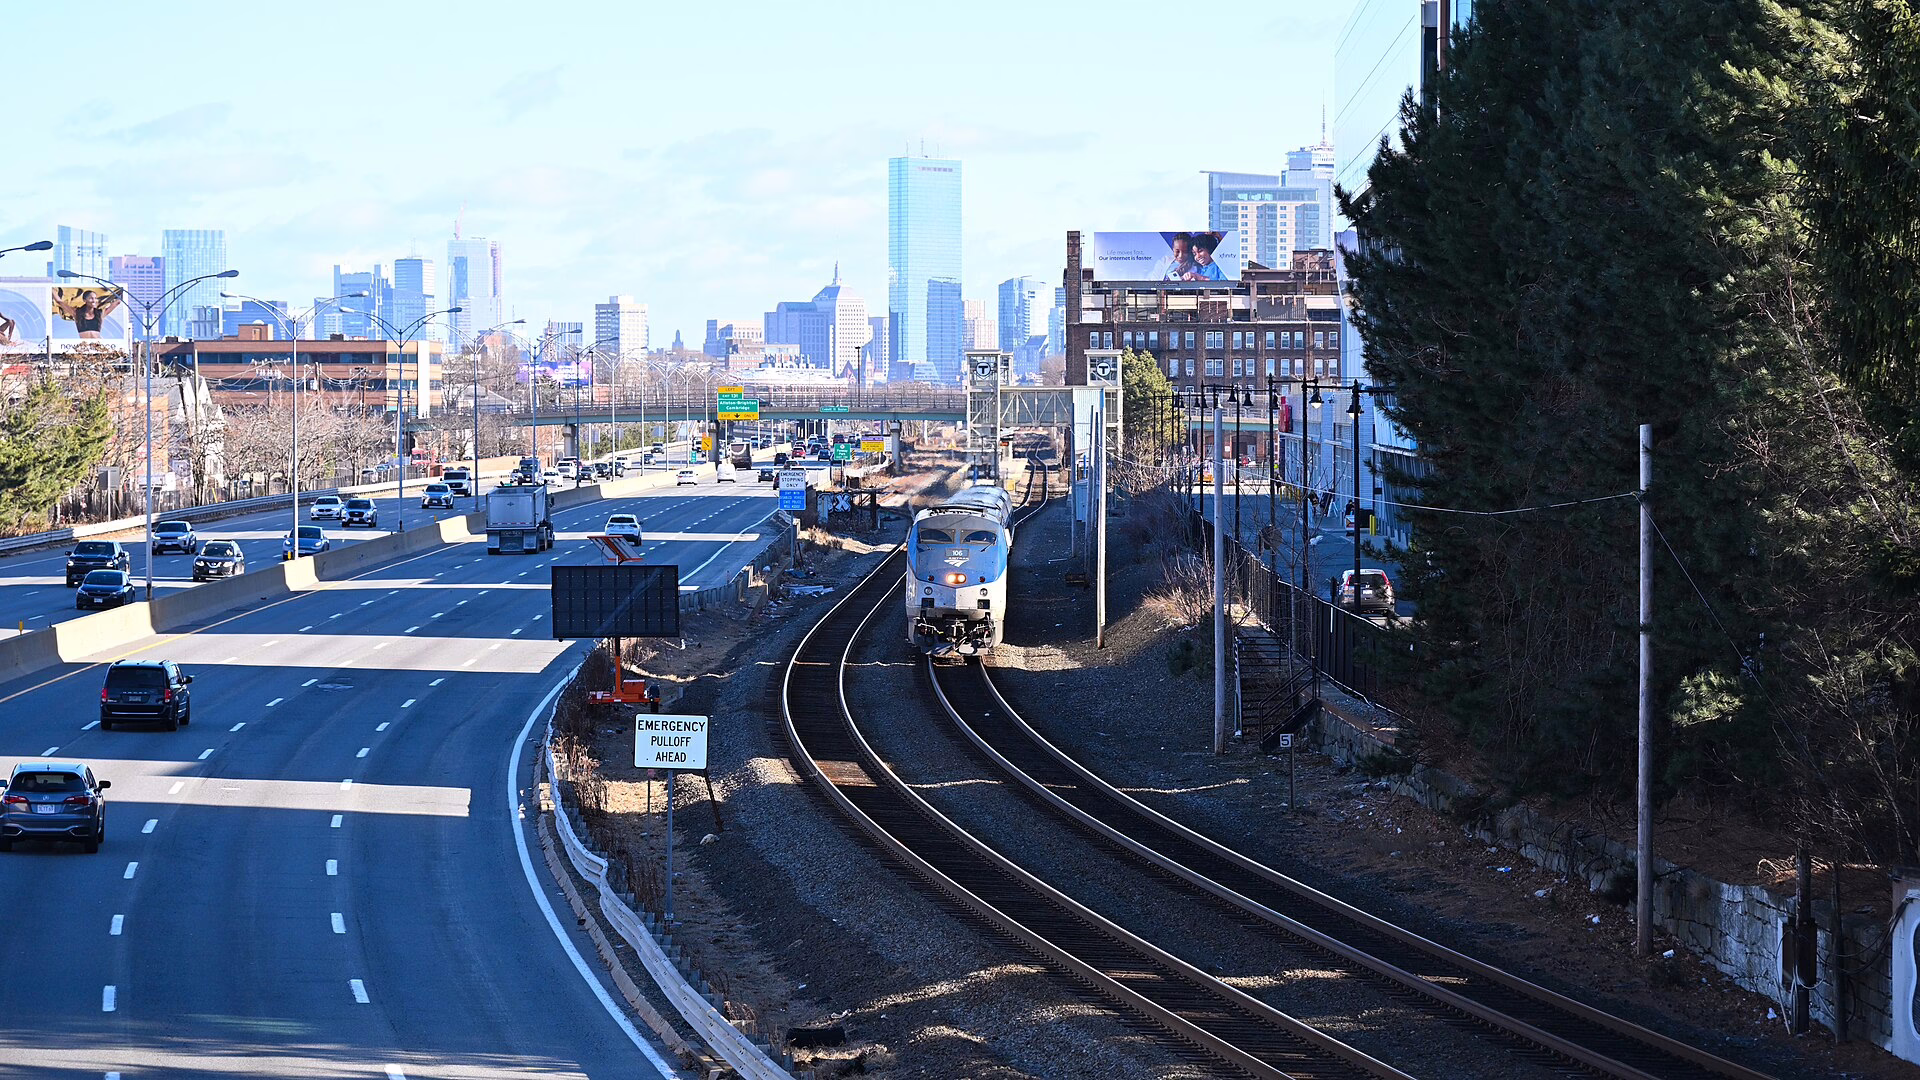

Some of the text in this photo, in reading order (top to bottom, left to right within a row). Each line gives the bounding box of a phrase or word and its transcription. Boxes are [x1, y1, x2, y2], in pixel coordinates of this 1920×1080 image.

[638, 720, 705, 732] EMERGENCY
[651, 736, 691, 746] PULLOFF
[1282, 736, 1290, 746] 5
[656, 752, 686, 762] AHEAD
